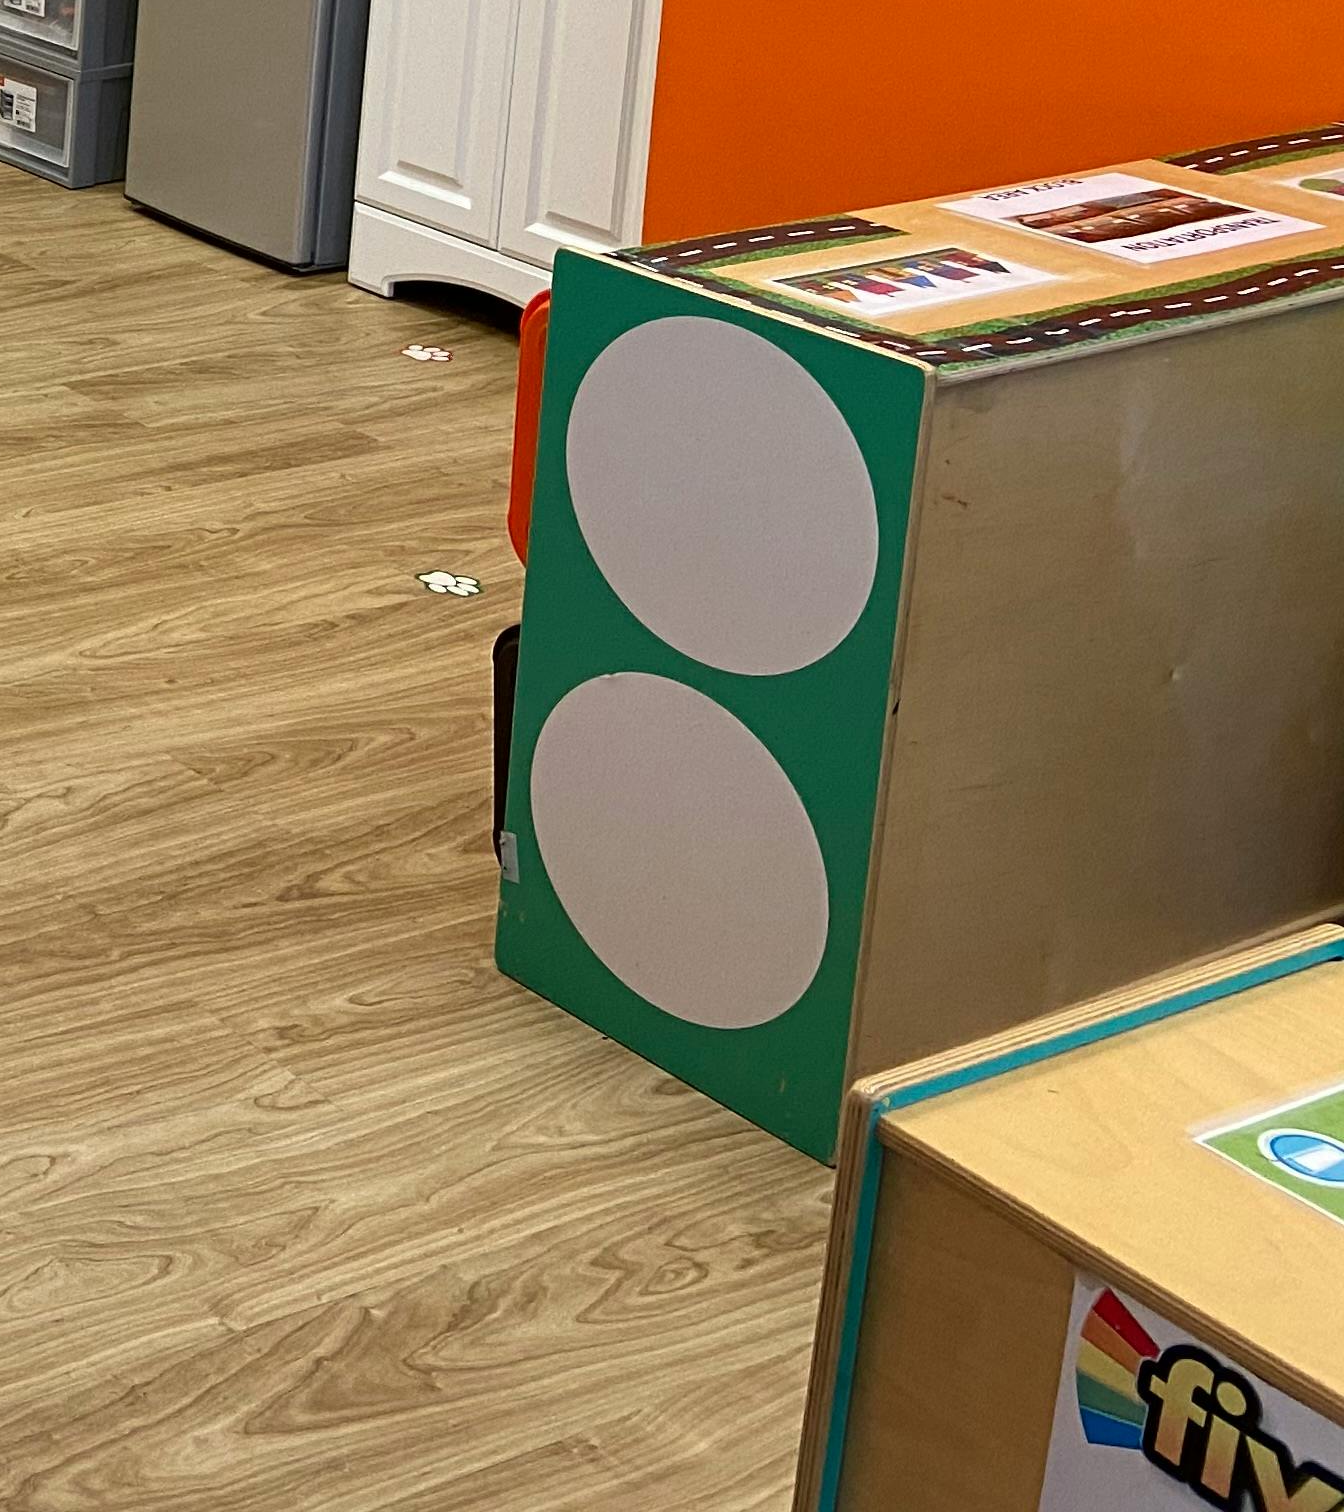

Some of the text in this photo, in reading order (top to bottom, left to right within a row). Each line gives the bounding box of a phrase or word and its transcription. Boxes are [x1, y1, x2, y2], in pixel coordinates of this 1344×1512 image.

[980, 178, 1083, 202] BLOCK AREA
[1121, 215, 1281, 252] TRANSPORTATION
